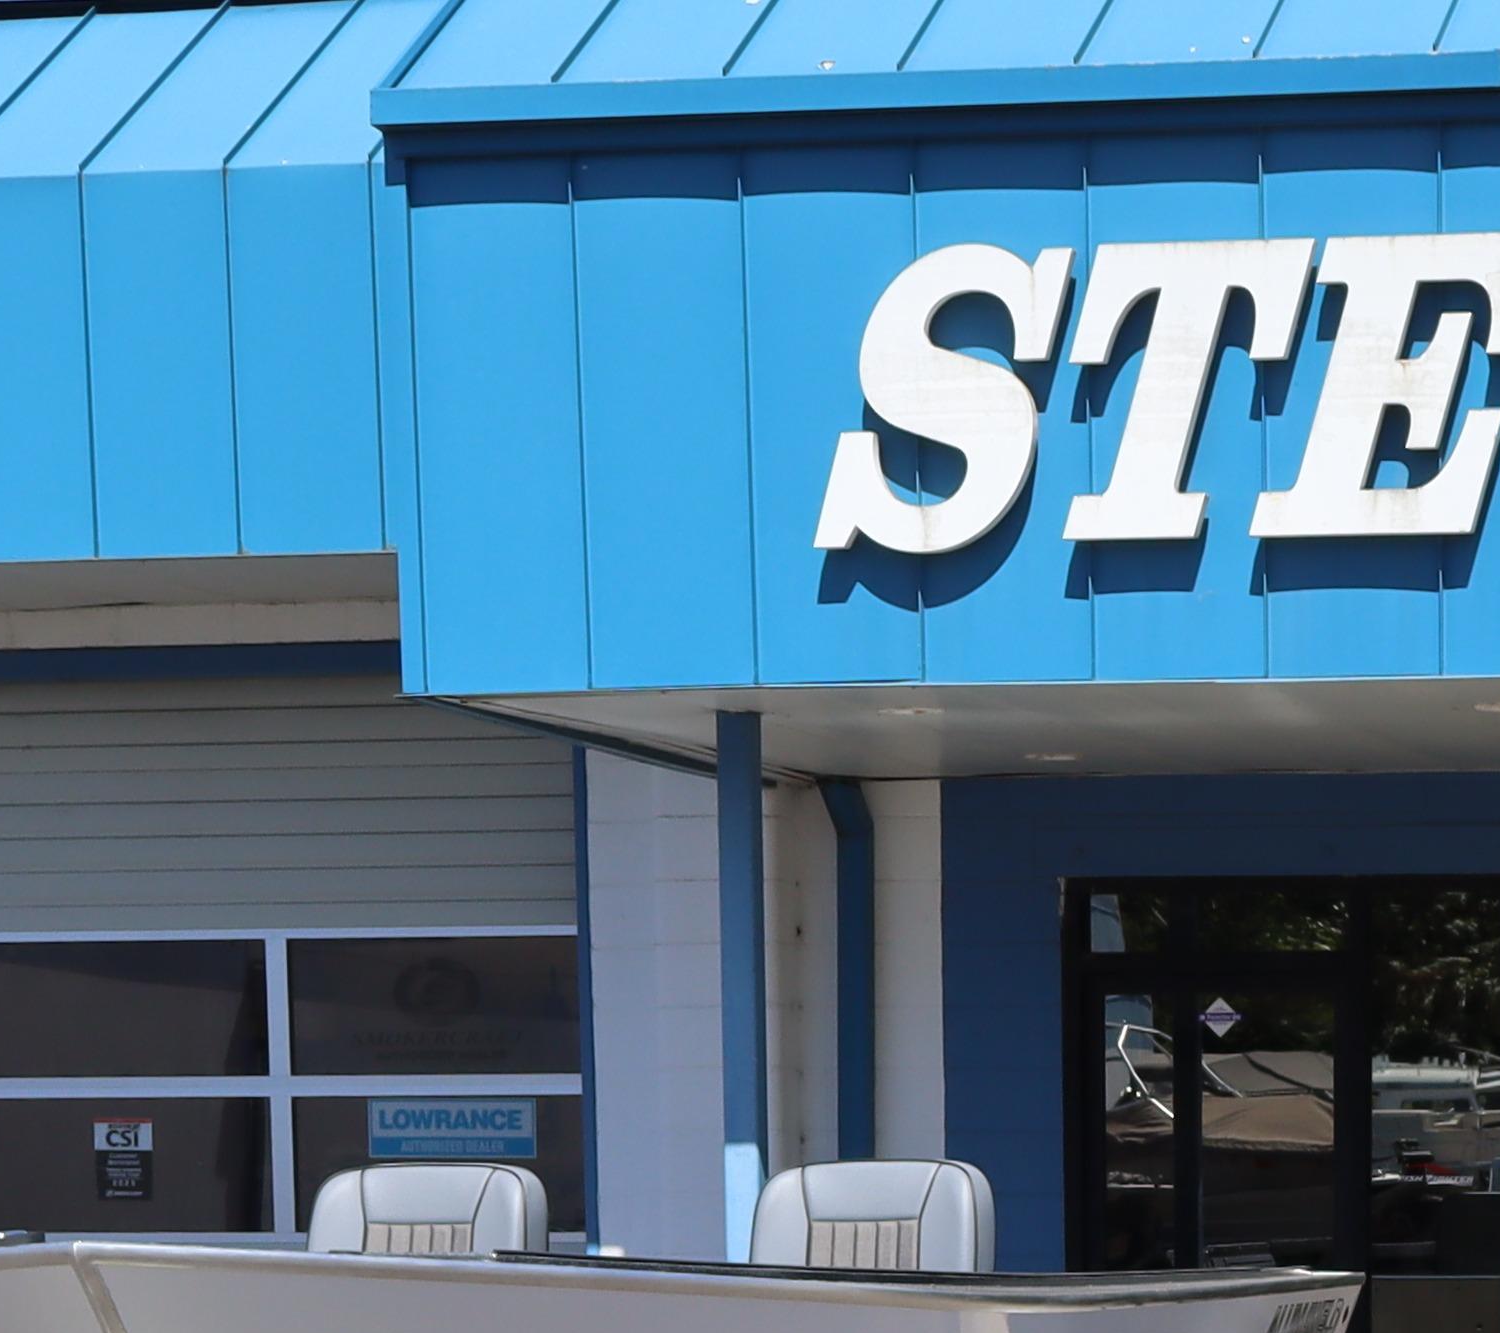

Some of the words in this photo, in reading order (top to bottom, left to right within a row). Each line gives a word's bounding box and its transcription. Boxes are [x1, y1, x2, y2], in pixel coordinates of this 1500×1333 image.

[378, 1108, 523, 1131] LOWRANCE
[401, 1140, 464, 1154] AUTHORIZED
[465, 1140, 506, 1154] DEALER
